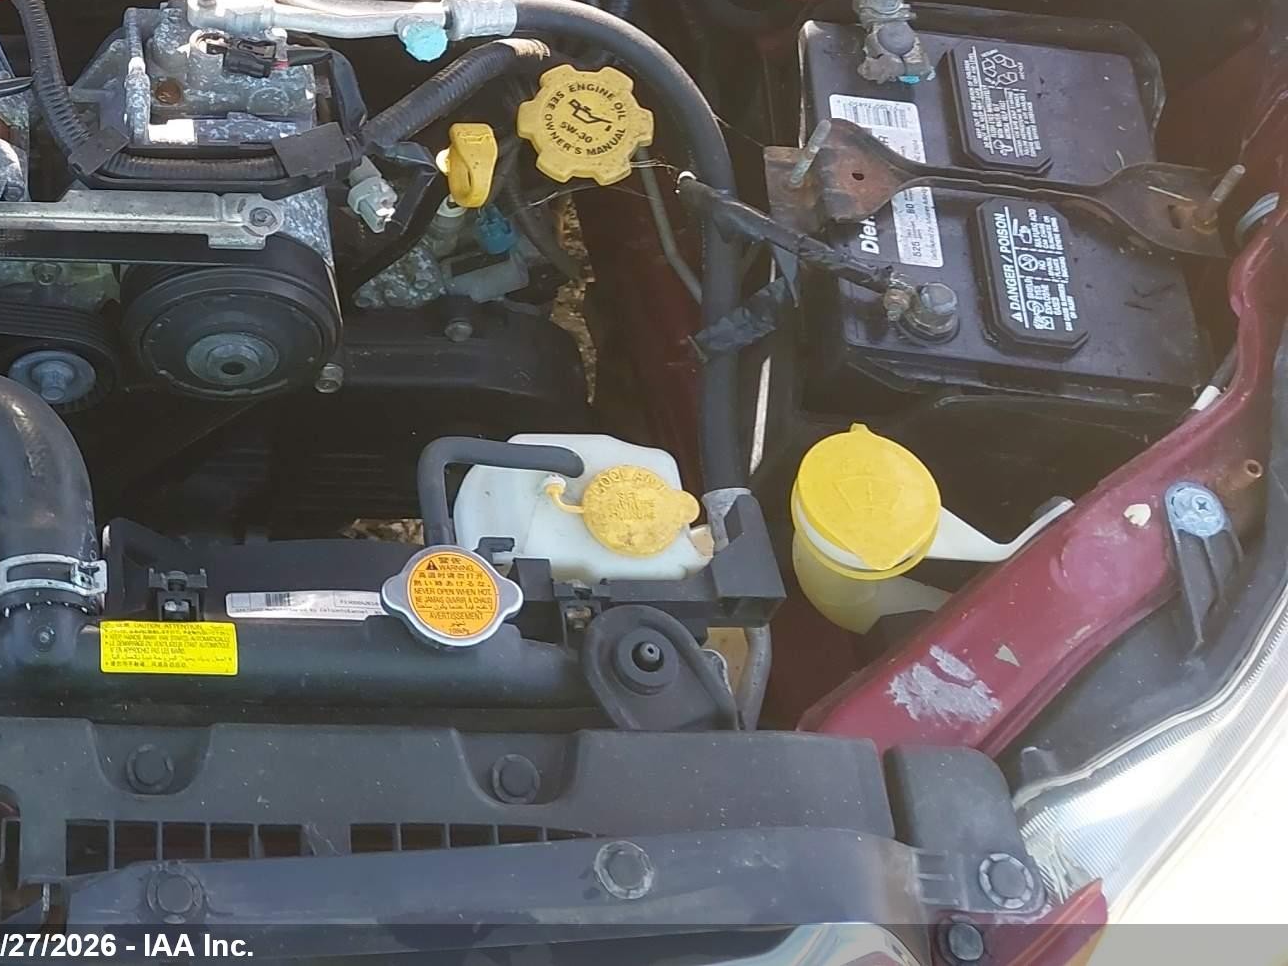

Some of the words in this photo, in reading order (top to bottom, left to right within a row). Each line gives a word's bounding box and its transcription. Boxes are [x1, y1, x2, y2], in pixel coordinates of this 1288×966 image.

[549, 90, 565, 111] SEE
[567, 83, 616, 101] ENGINE
[614, 101, 627, 121] OIL
[544, 113, 582, 155] OWNER'S
[560, 121, 593, 143] 5W-30
[586, 128, 626, 156] MANUAL
[994, 213, 1012, 254] POISON
[912, 241, 922, 258] 525
[1001, 254, 1014, 263] /
[1038, 260, 1047, 270] NO
[1002, 264, 1021, 311] DANGER
[445, 596, 466, 604] OUVRIR
[430, 612, 483, 620] AVERTISSEMENT
